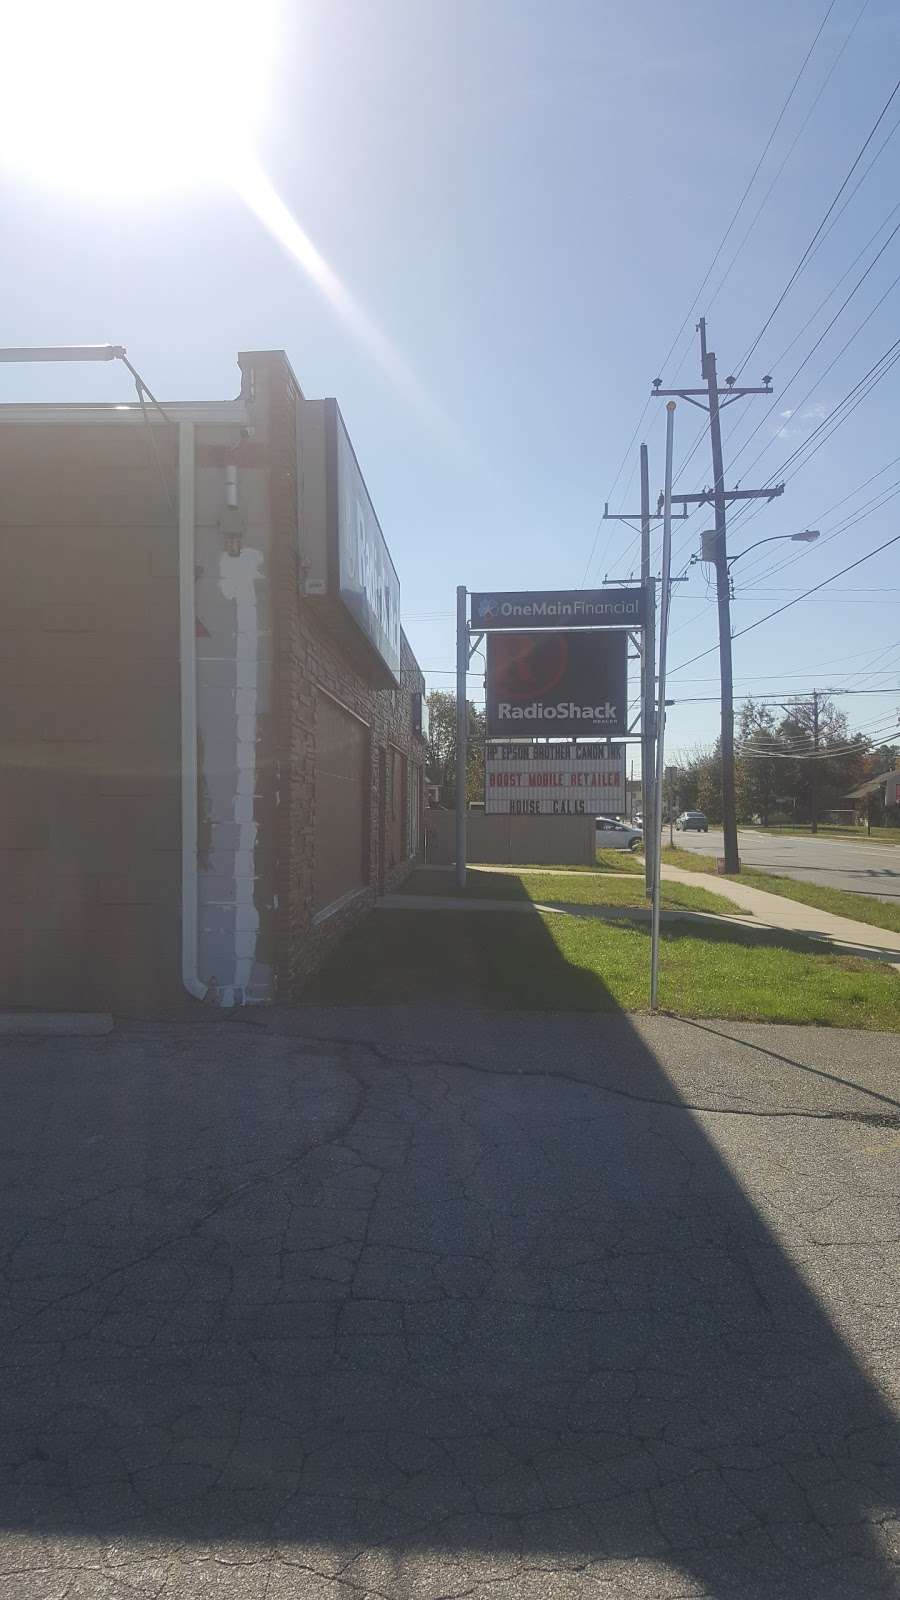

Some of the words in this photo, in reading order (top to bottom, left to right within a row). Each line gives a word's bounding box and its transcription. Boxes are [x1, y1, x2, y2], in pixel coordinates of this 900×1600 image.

[498, 702, 617, 719] RadioShack
[503, 746, 529, 760] EPSON
[533, 746, 571, 760] BROTHER
[576, 745, 603, 760] CANON
[490, 773, 522, 786] BOOST
[529, 773, 564, 786] MOBILE
[510, 799, 541, 816] HOUSE
